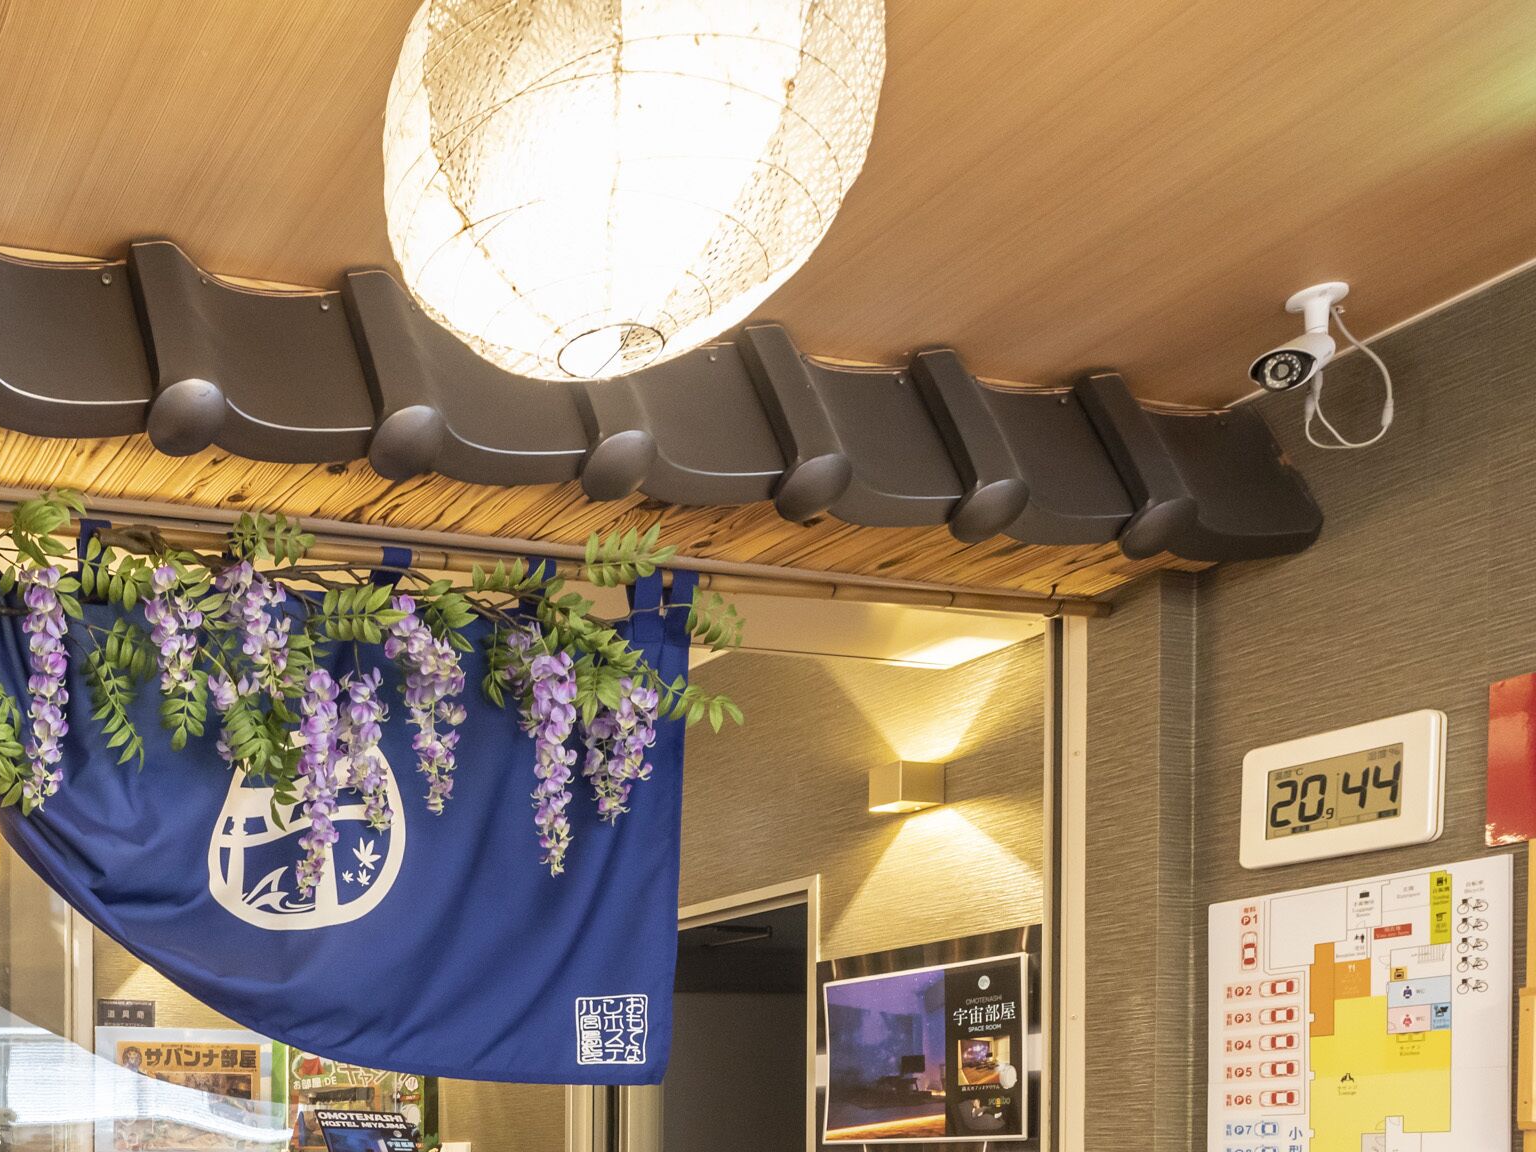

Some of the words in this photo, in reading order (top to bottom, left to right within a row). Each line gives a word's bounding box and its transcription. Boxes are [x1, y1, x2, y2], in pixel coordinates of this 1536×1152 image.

[1342, 760, 1402, 809] 44
[965, 994, 1002, 1005] OMOTENASHI
[952, 1001, 1016, 1026] 宇宙部屋
[968, 1024, 985, 1033] SPACE
[985, 1023, 1002, 1032] ROOM
[145, 1047, 257, 1069] サバンナ部屋
[293, 1077, 321, 1090] お部屋
[324, 1077, 337, 1086] DE
[318, 1111, 404, 1123] OMOTENASHI
[320, 1120, 360, 1128] HOSTEL
[361, 1121, 407, 1130] MIYAJIMA
